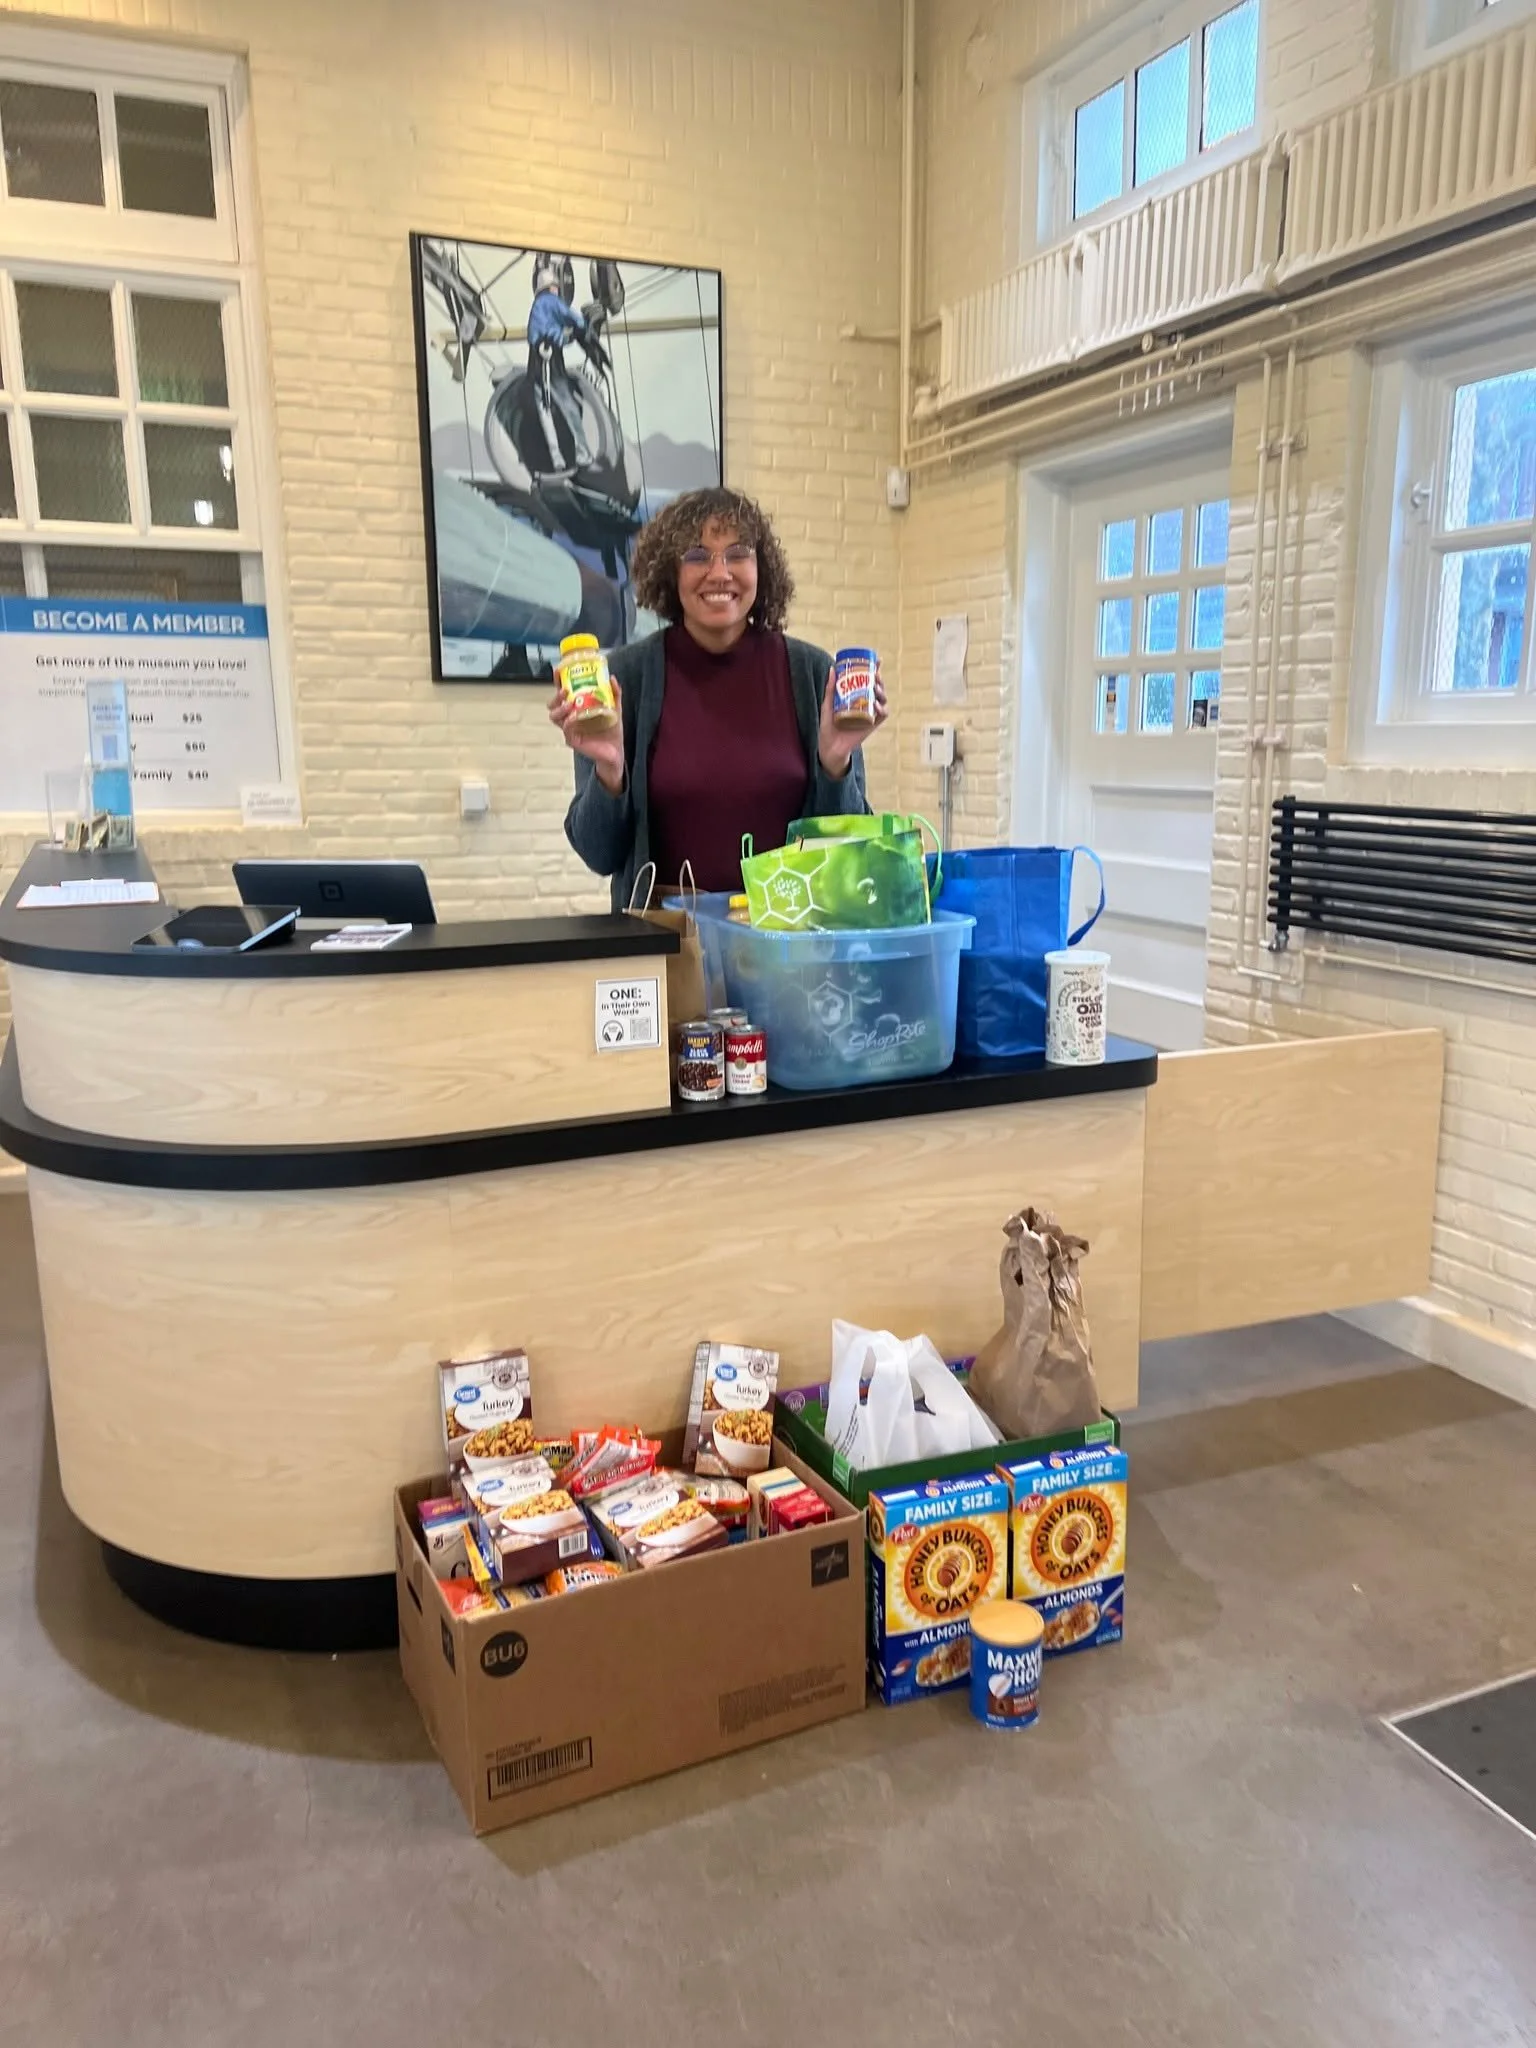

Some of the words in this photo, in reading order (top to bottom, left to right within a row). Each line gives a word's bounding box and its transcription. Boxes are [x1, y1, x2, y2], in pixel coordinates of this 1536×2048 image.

[33, 609, 128, 632] BECOME
[133, 613, 149, 632] A
[152, 613, 246, 635] MEMBER
[36, 655, 58, 667] Get
[62, 657, 95, 668] more
[98, 656, 111, 668] of
[114, 656, 135, 668] the
[138, 659, 189, 669] museum
[193, 660, 216, 672] you
[218, 658, 247, 670] love!
[601, 1002, 609, 1011] In
[612, 1001, 631, 1009] Their
[632, 1000, 651, 1008] Own
[610, 987, 642, 1001] ONE:
[613, 1007, 639, 1017] Words
[849, 1020, 926, 1050] ShopRite
[736, 1383, 762, 1397] Turkey
[482, 1398, 515, 1411] Turkey
[1032, 1468, 1082, 1493] FAMILY
[1083, 1461, 1113, 1481] SIZE
[905, 1499, 957, 1522] FAMILY
[961, 1491, 993, 1512] SIZE
[1037, 1503, 1065, 1557] HONEY
[1066, 1497, 1109, 1541] BUNCHES
[910, 1534, 940, 1589] HONEY
[942, 1529, 988, 1573] BUNCHES
[1059, 1551, 1101, 1581] OATS
[935, 1583, 980, 1613] OATS
[1044, 1582, 1103, 1609] ALMONDS
[919, 1621, 970, 1646] ALMON
[987, 1645, 1042, 1671] MAXW
